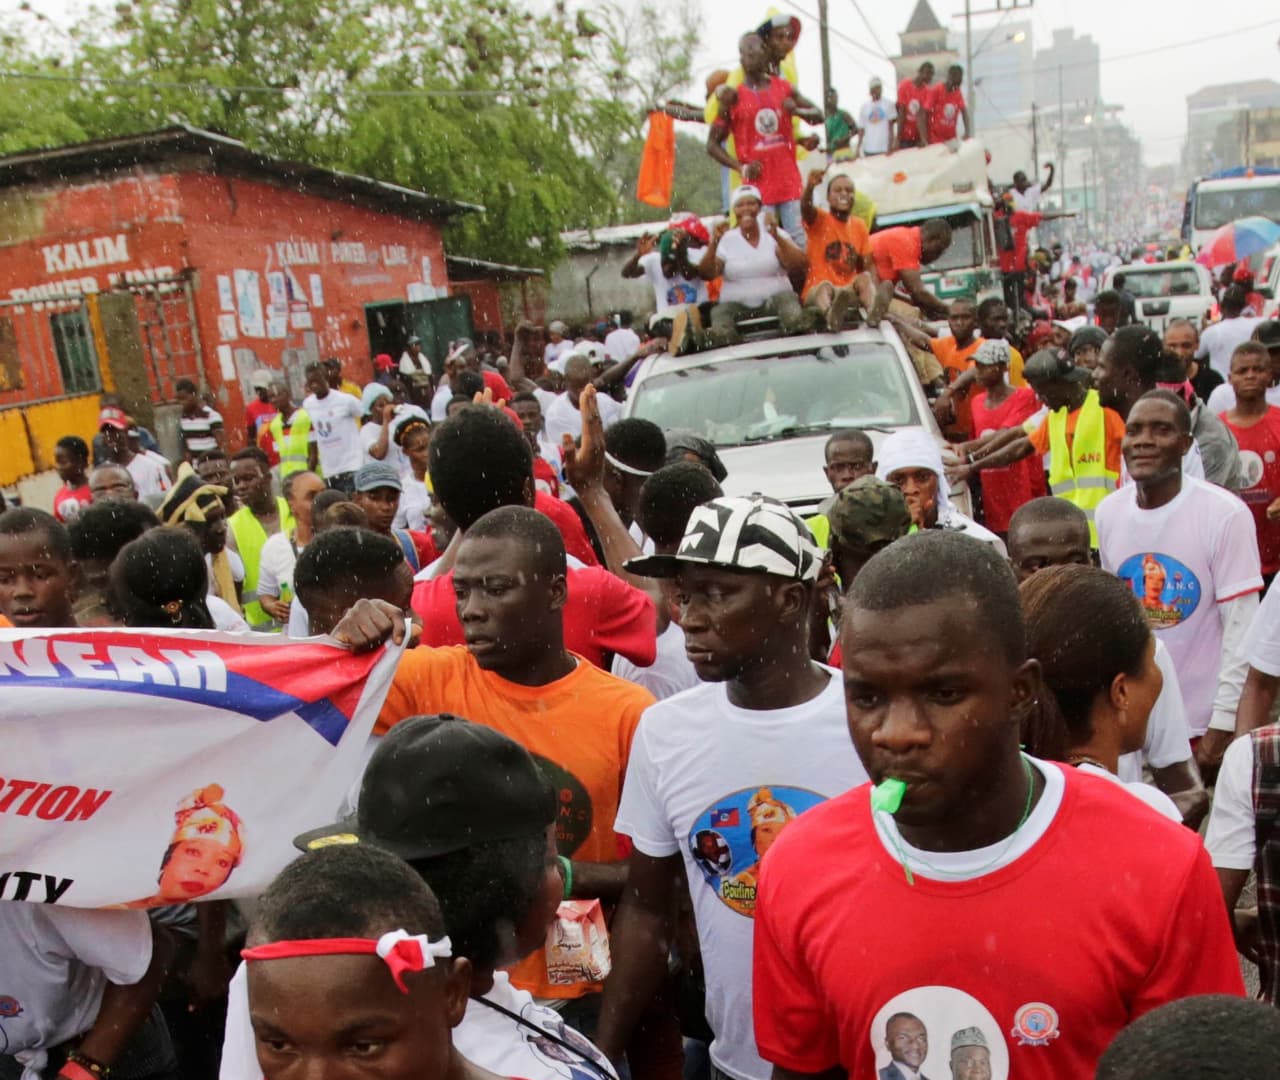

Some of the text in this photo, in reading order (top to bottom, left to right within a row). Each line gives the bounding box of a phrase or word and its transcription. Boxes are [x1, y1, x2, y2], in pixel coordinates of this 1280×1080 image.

[42, 234, 130, 273] KALIM
[275, 241, 320, 266] KALIM
[723, 881, 755, 900] Pauline
